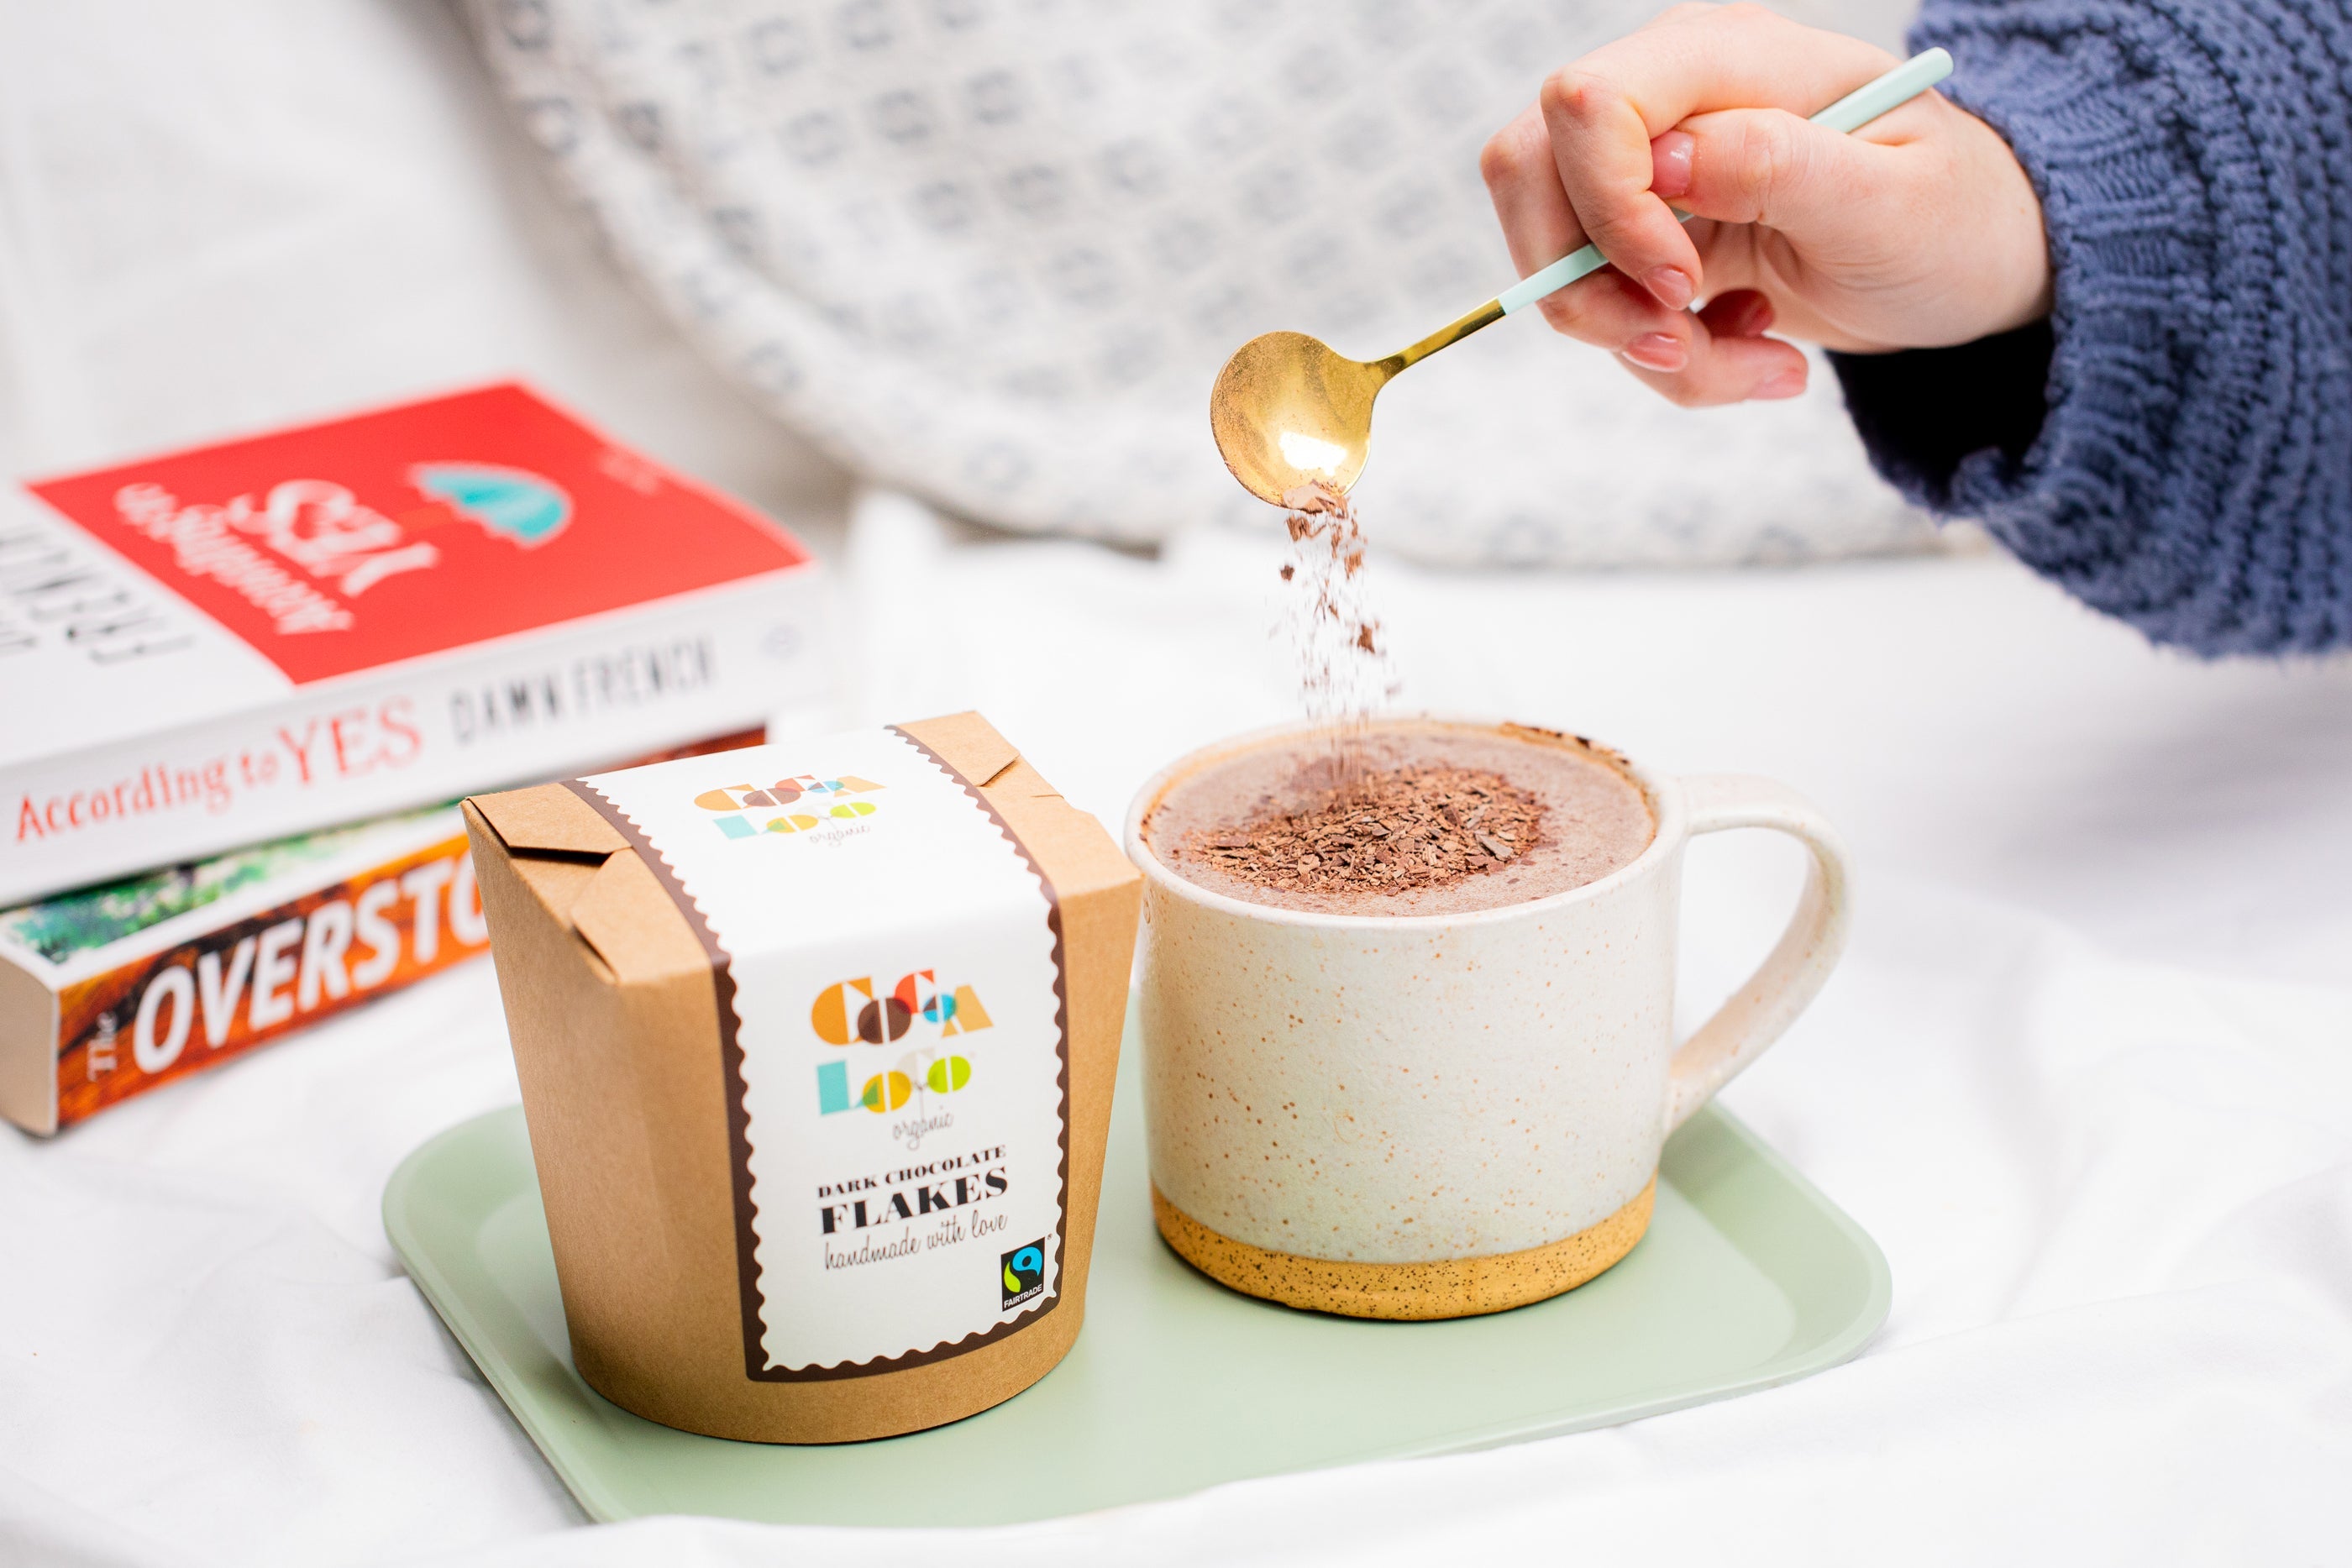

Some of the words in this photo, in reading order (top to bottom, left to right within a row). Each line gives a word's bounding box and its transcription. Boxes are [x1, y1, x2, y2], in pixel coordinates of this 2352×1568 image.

[14, 755, 233, 845] According
[239, 744, 281, 788] to
[275, 695, 424, 789] YES
[892, 1104, 954, 1151] organic
[817, 1176, 879, 1198] DARK
[885, 1144, 1006, 1185] CHOCOLATE
[820, 1166, 1009, 1235] FLAKES
[824, 1226, 921, 1270] handmade
[927, 1214, 967, 1251] with
[971, 1209, 1008, 1239] love
[1004, 1283, 1042, 1308] FAIRTRADE
